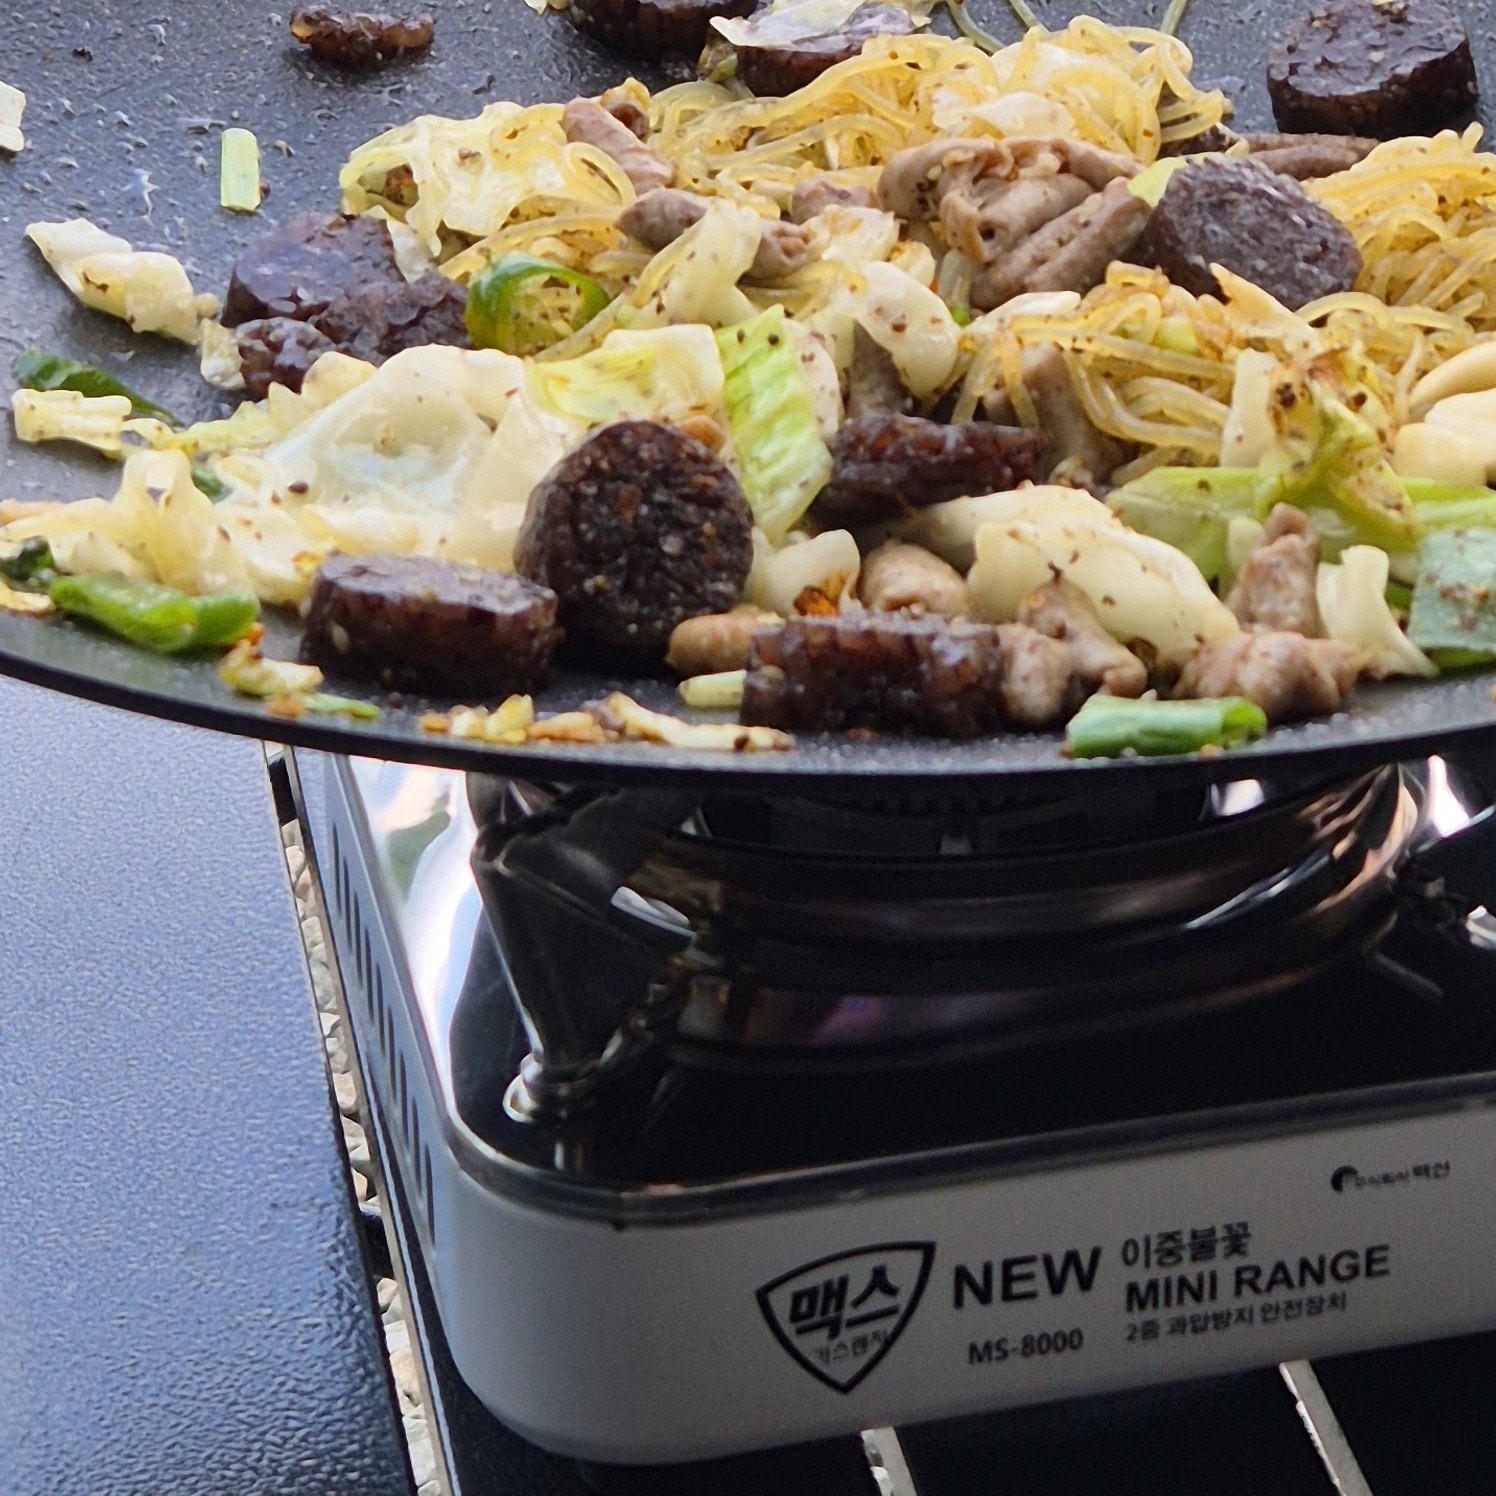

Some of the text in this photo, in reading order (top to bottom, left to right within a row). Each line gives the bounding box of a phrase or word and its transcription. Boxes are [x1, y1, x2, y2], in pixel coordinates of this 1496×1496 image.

[1121, 1221, 1252, 1269] 이중불꽃
[790, 1264, 900, 1340] 맥스
[953, 1246, 1102, 1310] NEW
[1126, 1243, 1391, 1312] MINI RANGE
[967, 1327, 1085, 1366] MS-8000
